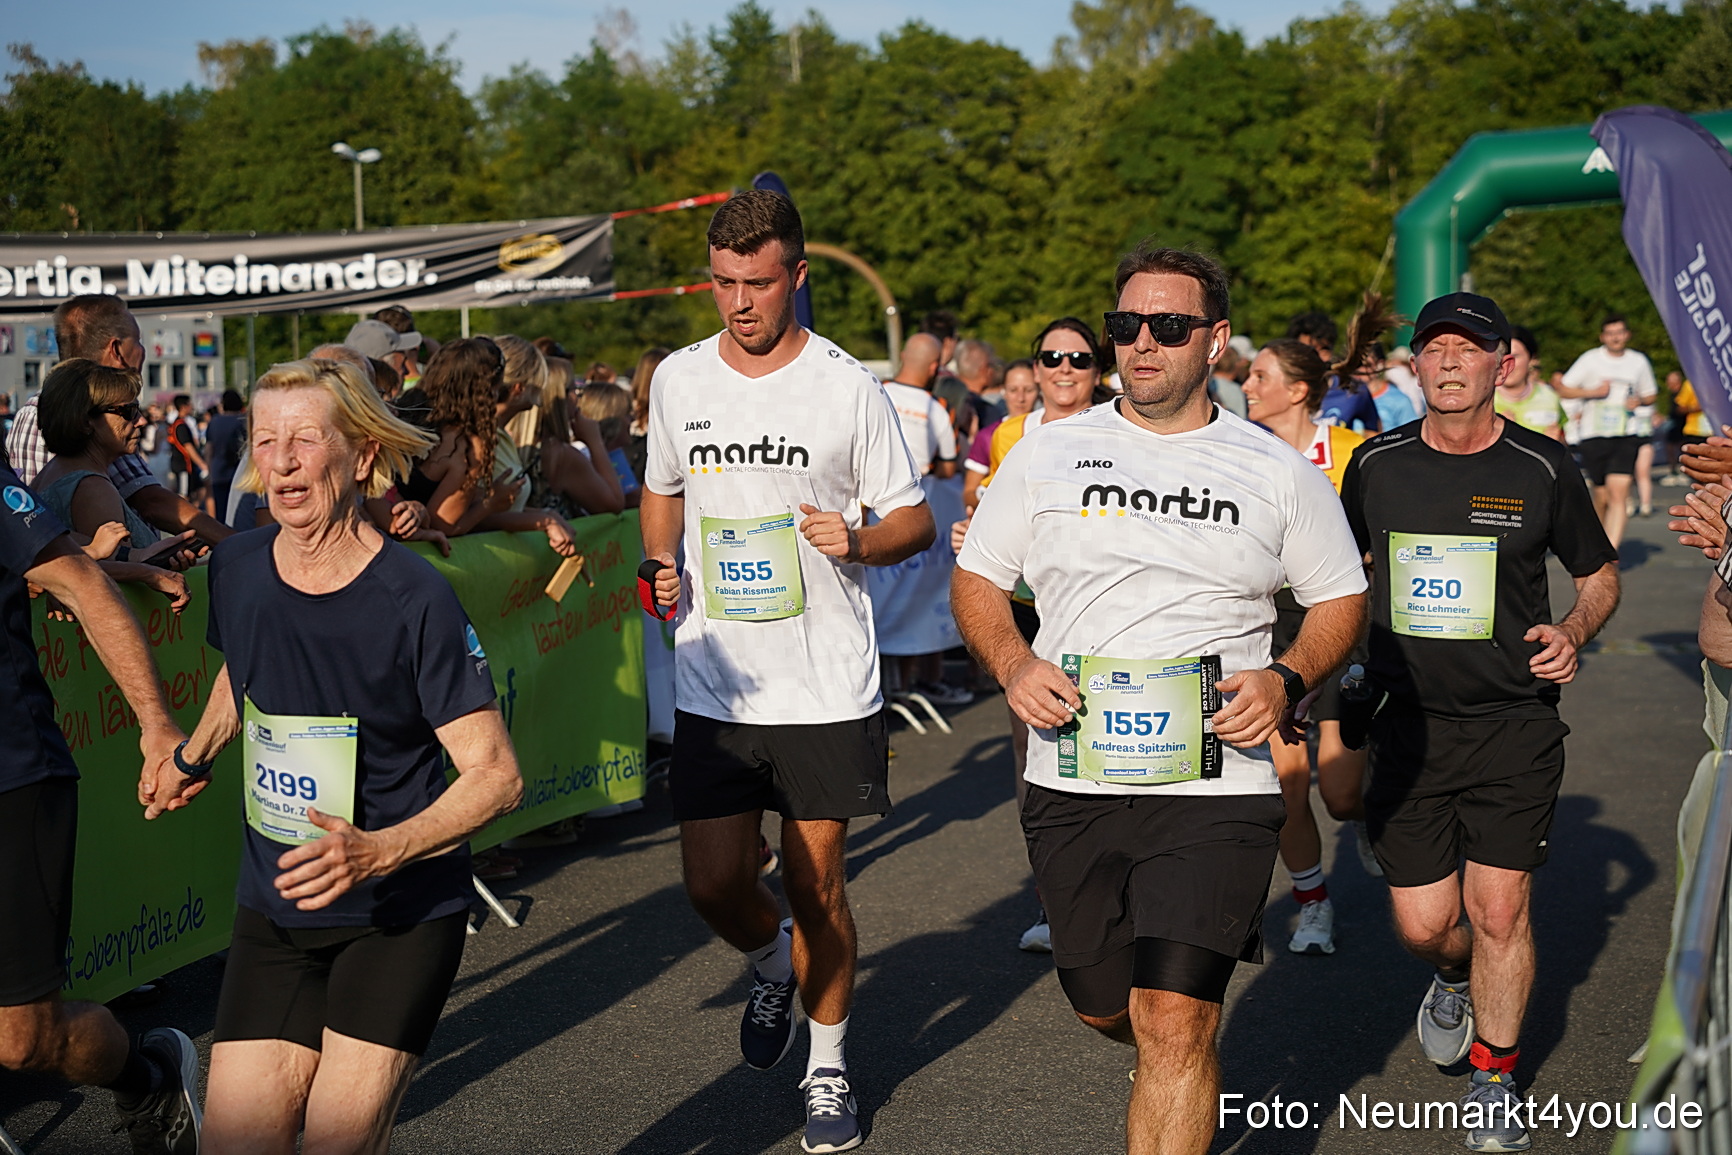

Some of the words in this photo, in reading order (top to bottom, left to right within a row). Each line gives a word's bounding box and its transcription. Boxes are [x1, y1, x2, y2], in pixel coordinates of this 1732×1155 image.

[126, 252, 438, 296] Miteinander.
[684, 420, 711, 431] JAKO
[689, 435, 809, 467] martin
[744, 466, 769, 474] FORMING
[769, 467, 809, 477] TECHNOLOGY
[1075, 460, 1113, 469] JAKO
[1082, 484, 1240, 526] martin
[1471, 503, 1523, 511] BERSCHNEIDER
[1472, 496, 1524, 504] BERSCHNEIDER
[1129, 511, 1153, 521] METAL
[1154, 516, 1189, 527] FORMING
[1190, 522, 1240, 535] TECHNOLOGY
[718, 560, 773, 582] 1555
[715, 585, 741, 595] Fabian
[742, 585, 787, 596] Rissmann
[1411, 577, 1462, 600] 250
[1407, 602, 1425, 613] Rico
[1427, 603, 1471, 614] Lehmeier
[1063, 663, 1078, 671] AOK
[1106, 683, 1144, 691] Firmenlauf
[1202, 701, 1208, 711] 20
[1103, 710, 1170, 736] 1557
[1091, 740, 1137, 752] Andreas
[1138, 742, 1187, 754] Spitzhirn
[1204, 735, 1214, 771] HILTL
[255, 762, 318, 801] 2199
[251, 788, 280, 811] Martina
[282, 802, 298, 815] Dr.
